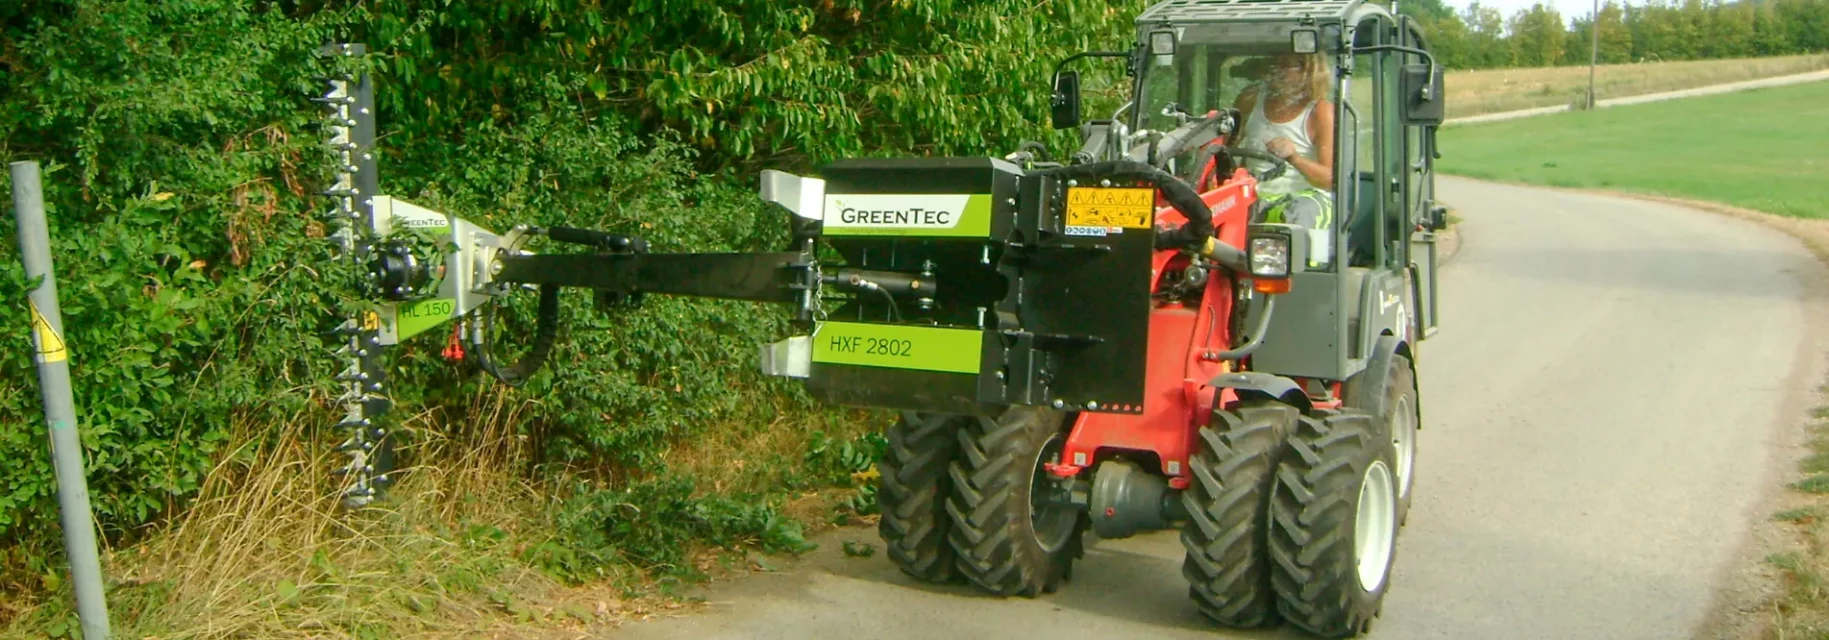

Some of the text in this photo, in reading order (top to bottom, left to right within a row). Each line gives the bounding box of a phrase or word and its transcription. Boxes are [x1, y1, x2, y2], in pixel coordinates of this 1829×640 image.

[402, 301, 451, 318] HL 150
[830, 336, 912, 357] HXF 2802
